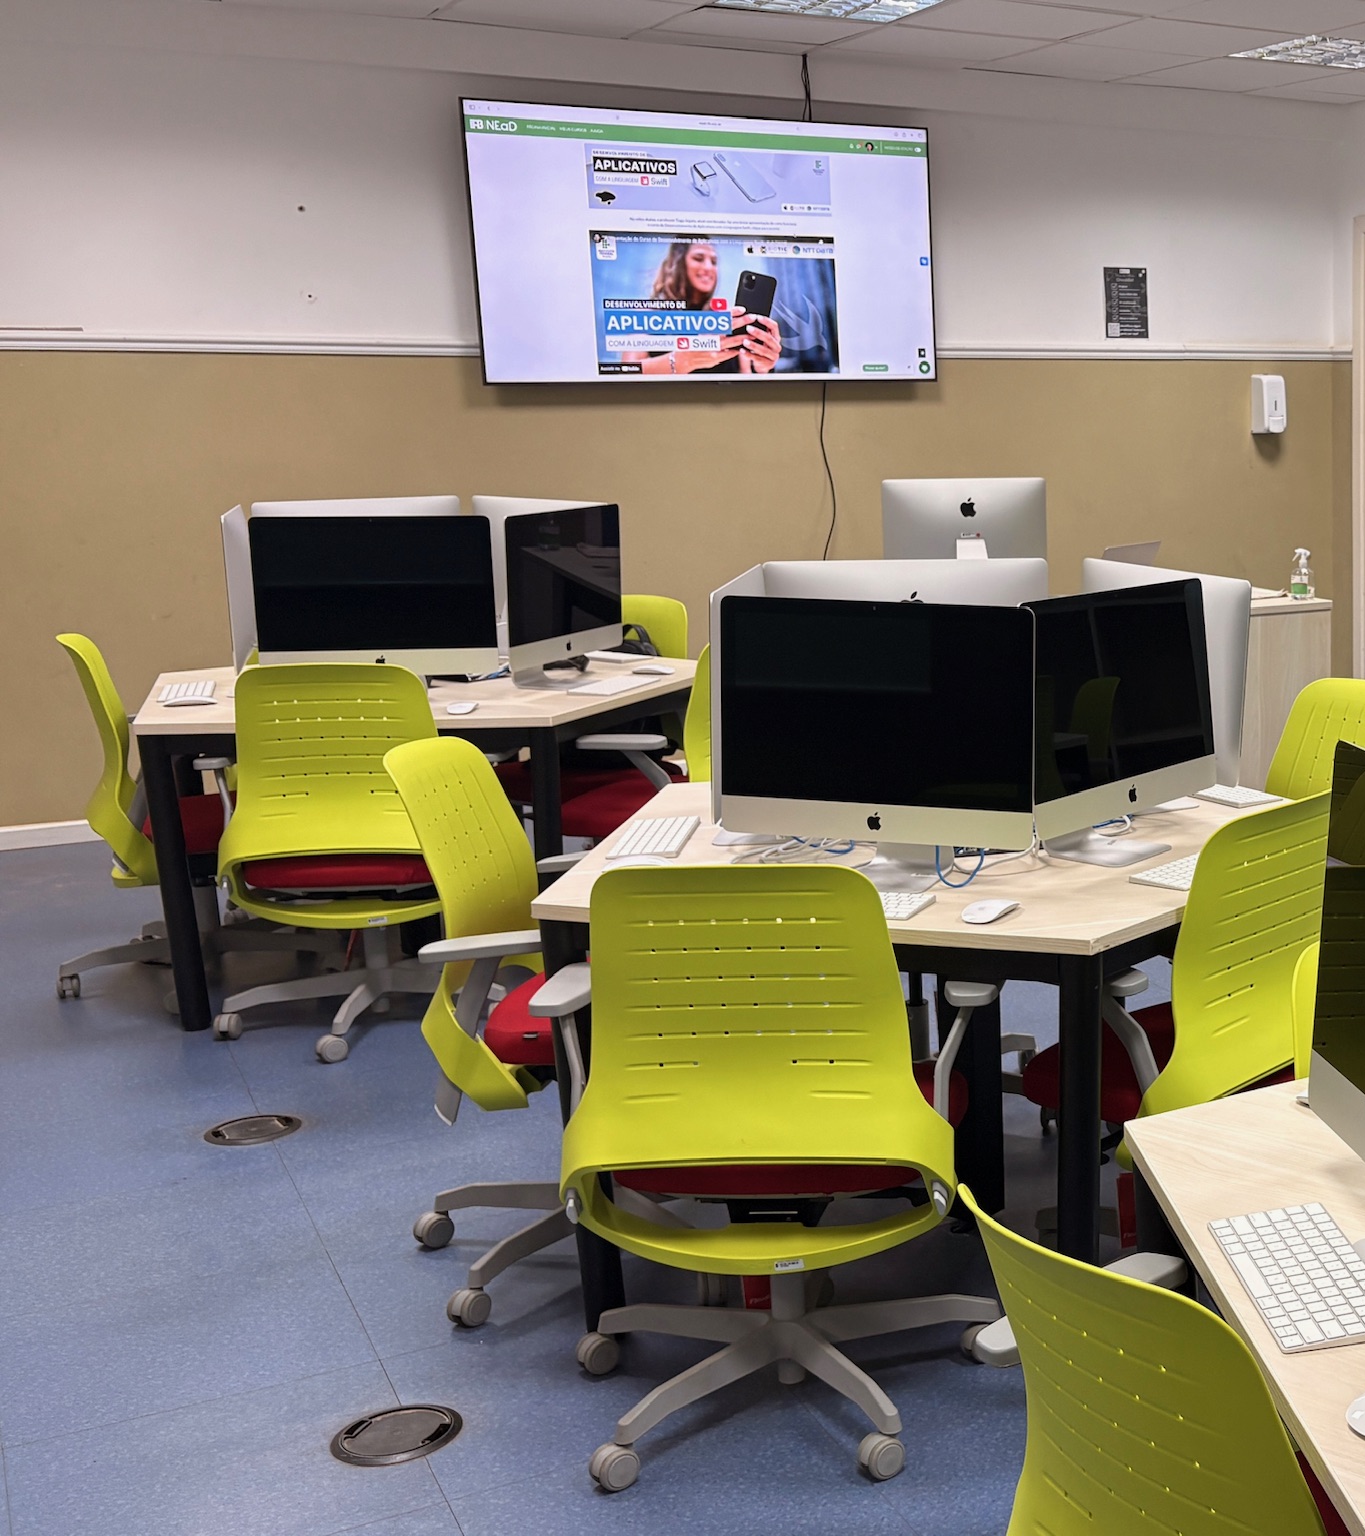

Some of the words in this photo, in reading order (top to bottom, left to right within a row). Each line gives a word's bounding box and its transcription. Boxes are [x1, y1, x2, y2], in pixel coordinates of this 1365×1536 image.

[486, 119, 518, 132] NEaD
[594, 159, 675, 173] APLICATIVOS
[651, 178, 668, 186] Swift
[605, 300, 675, 308] DESENVOLVIMENTO
[607, 315, 730, 331] APLICATIVOS
[692, 338, 717, 348] Swift
